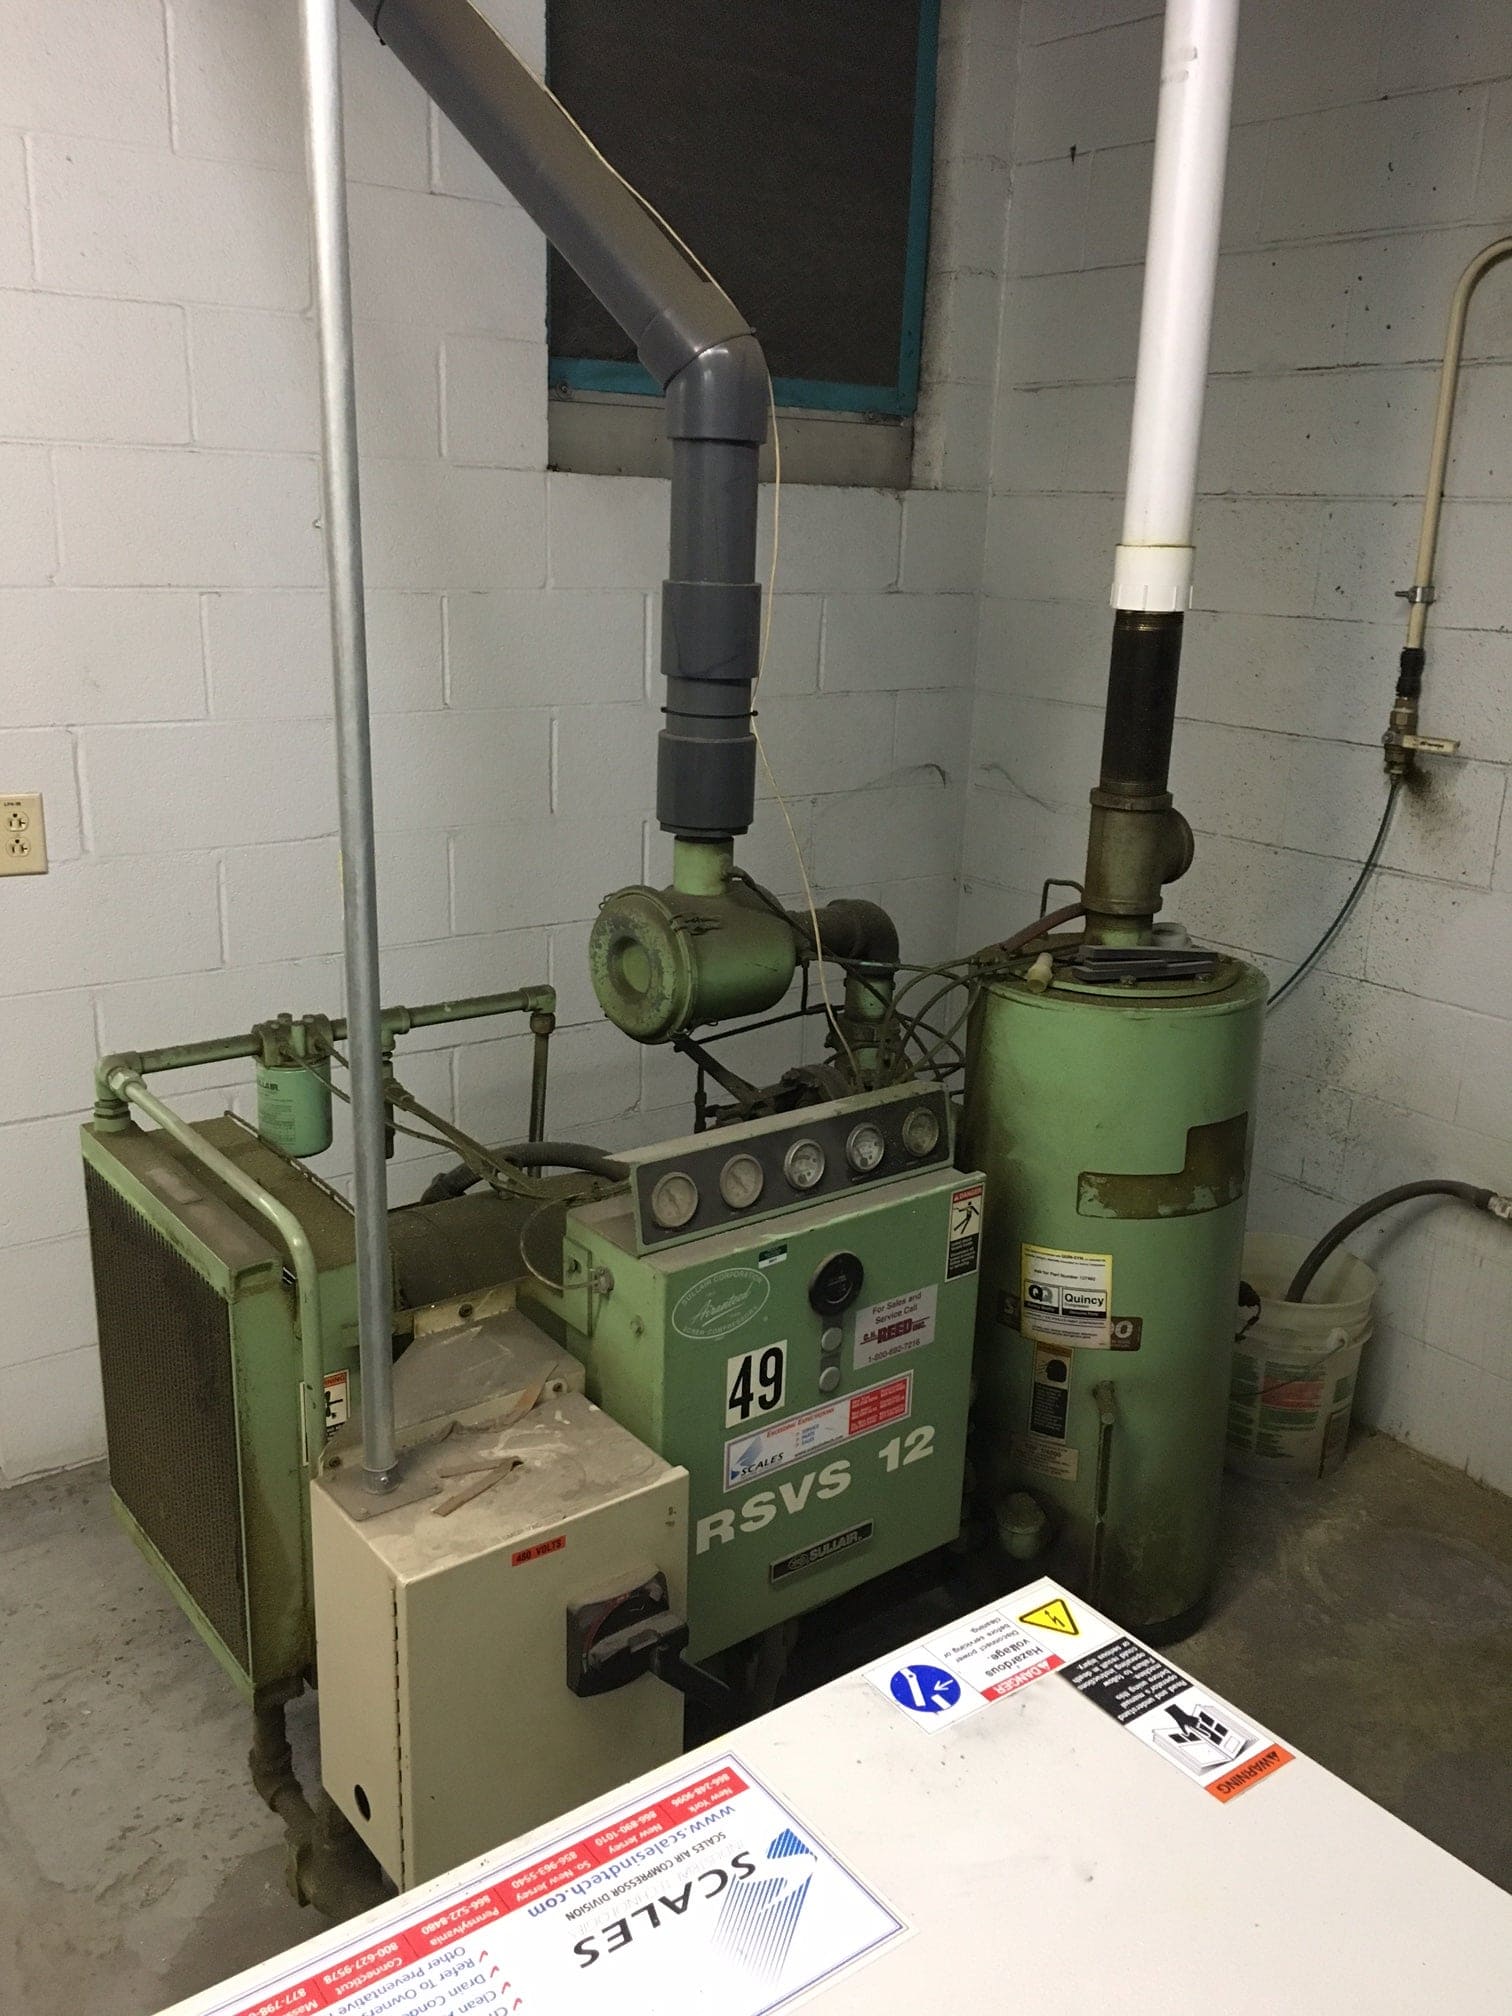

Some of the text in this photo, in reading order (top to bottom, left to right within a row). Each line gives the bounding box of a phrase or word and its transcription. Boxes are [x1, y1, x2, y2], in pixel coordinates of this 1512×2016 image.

[872, 1292, 922, 1314] For Sales and
[875, 1304, 918, 1325] Service Call
[1064, 1292, 1105, 1306] Quincy
[877, 1318, 913, 1344] REED
[729, 1347, 784, 1420] 49
[741, 1452, 784, 1476] SCALES
[696, 1460, 852, 1555] RSVS
[879, 1425, 935, 1473] 12
[536, 1539, 562, 1555] VOLTS
[809, 1531, 858, 1561] SULLAIR
[985, 1647, 1044, 1677] Hazardous
[993, 1664, 1042, 1694] DANGER
[1117, 1680, 1188, 1721] Read and understand
[1216, 1757, 1272, 1794] WARNING
[688, 1787, 733, 1813] New York
[594, 1810, 657, 1847] 866-890-1010
[608, 1823, 663, 1854] New Jersey
[511, 1851, 578, 1889] 856-963-5540
[527, 1804, 736, 1920] www.scalesindtech.com
[564, 1831, 726, 1921] SCALES AIR COMPRESSOR DIVISION
[516, 1860, 592, 1902] So. New Jersey
[421, 1894, 491, 1935] 866-522-8480
[429, 1906, 500, 1947] Pennsylvania
[573, 1851, 756, 1969] SCALES
[323, 1942, 399, 1985] 800-627-9578
[334, 1957, 404, 1996] Connecticut
[339, 1946, 466, 2015] Other Preventative
[439, 1958, 475, 1981] Refer
[419, 1978, 437, 1991] To
[448, 1974, 486, 1998] Drain
[458, 1990, 497, 2014] Clean
